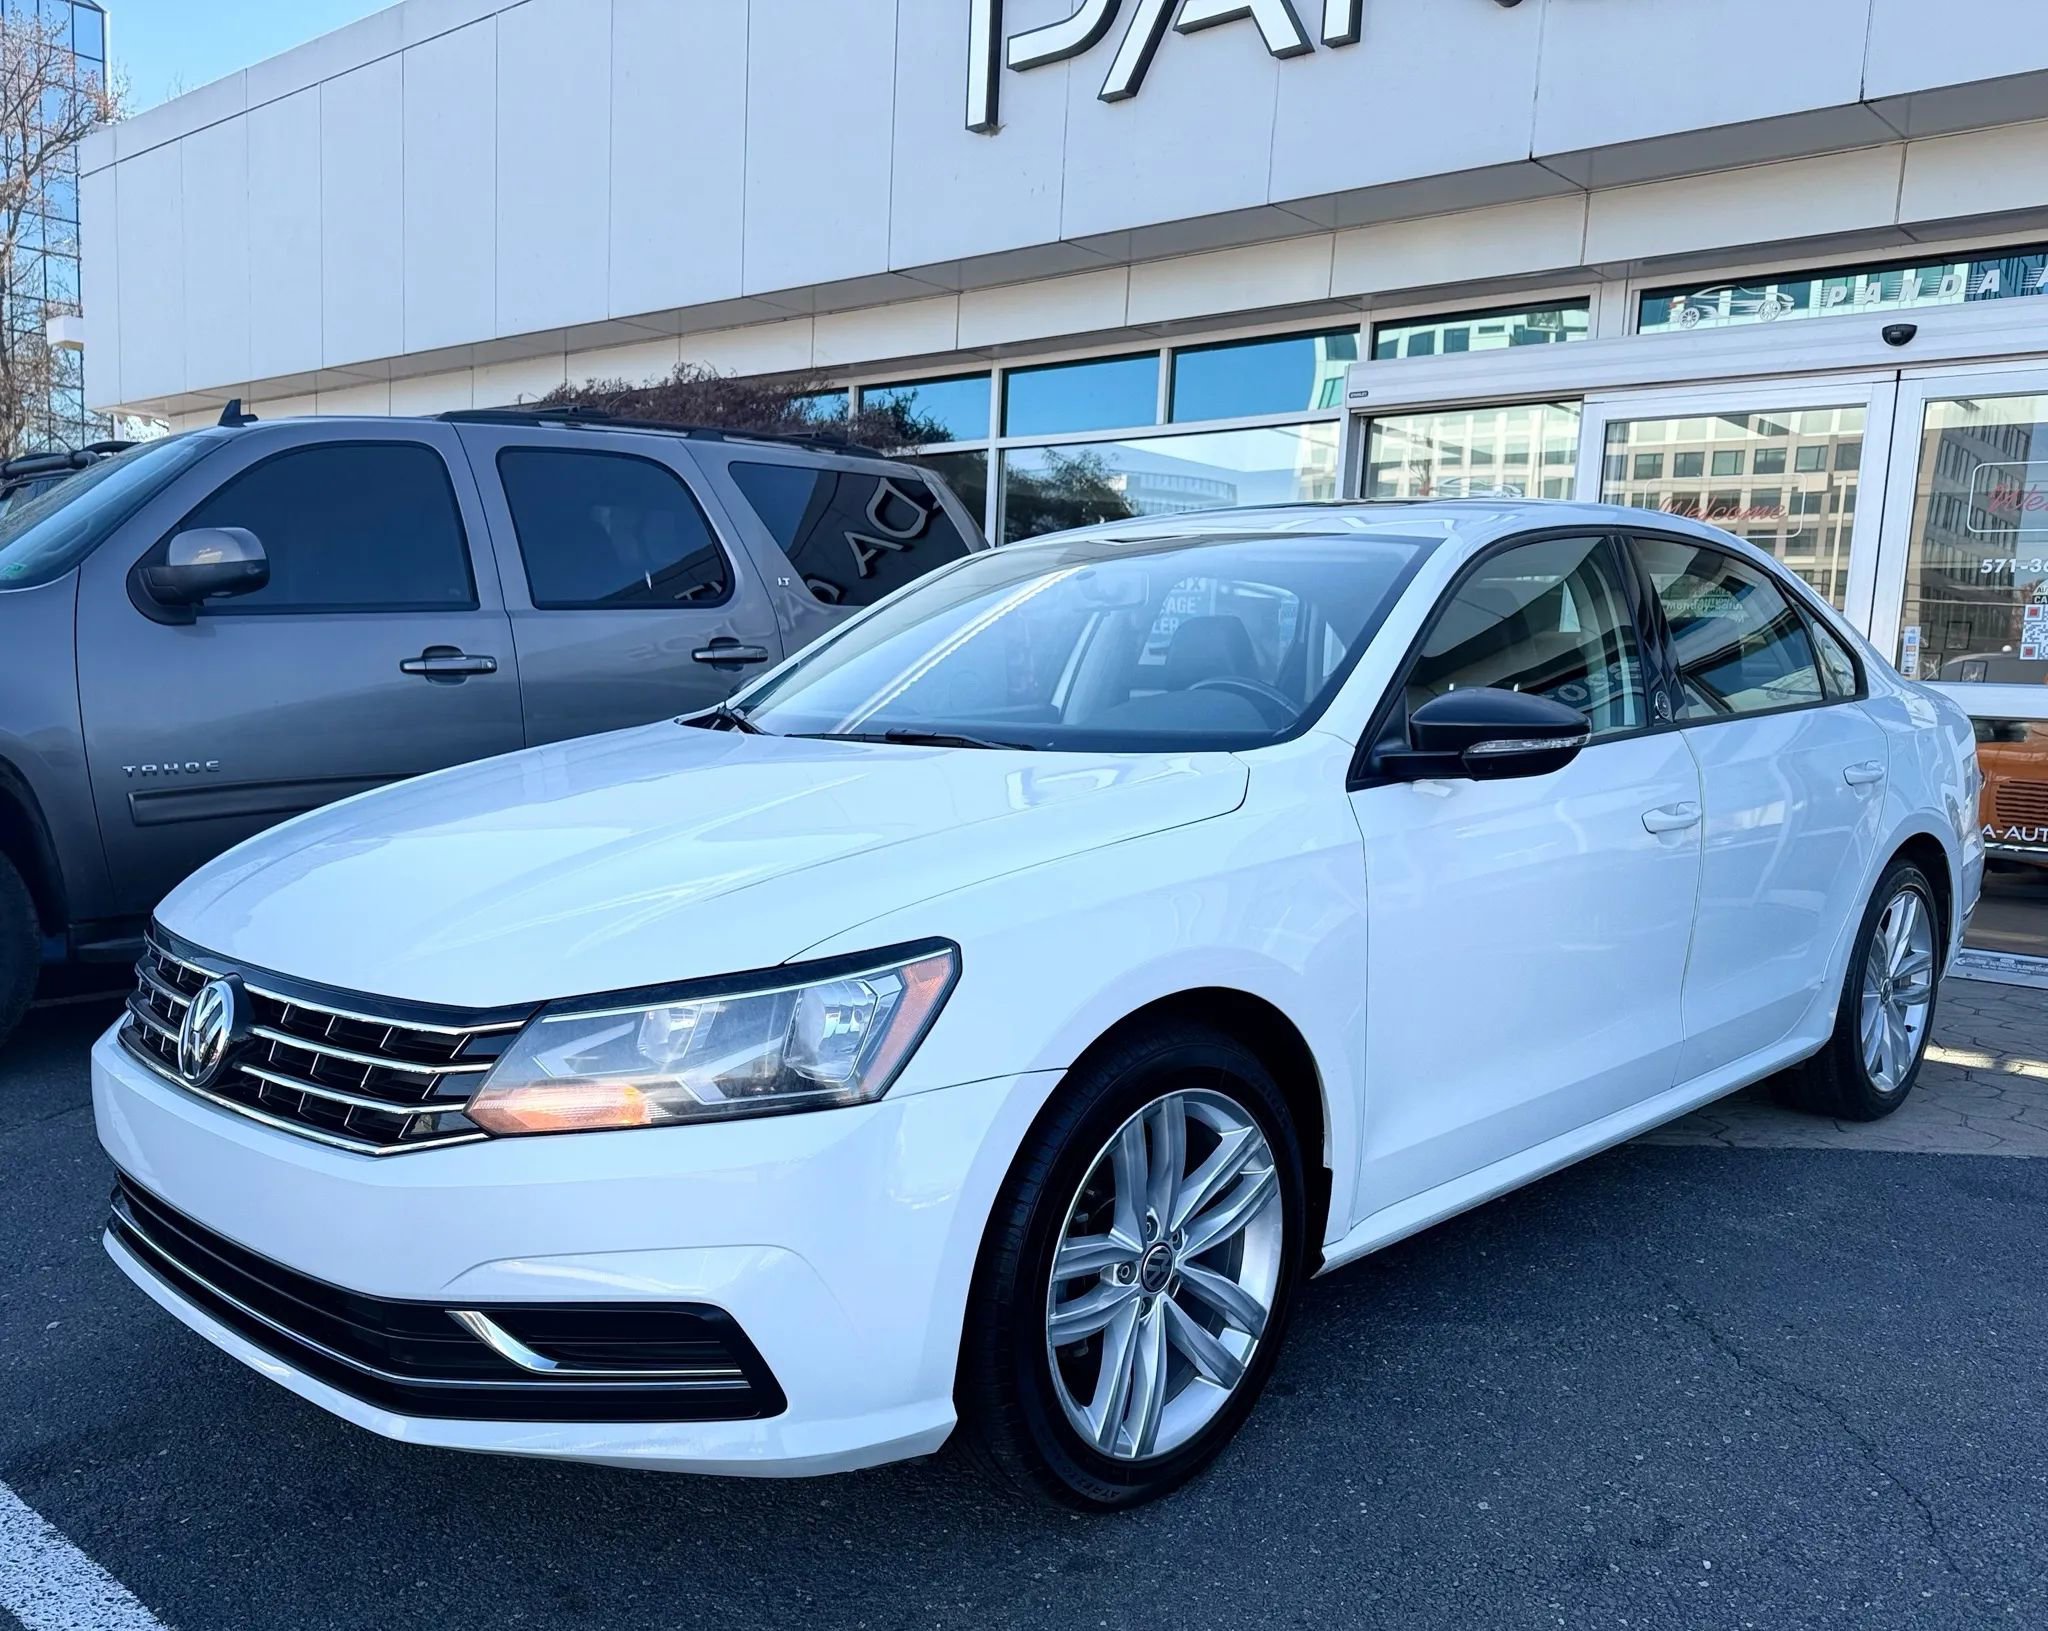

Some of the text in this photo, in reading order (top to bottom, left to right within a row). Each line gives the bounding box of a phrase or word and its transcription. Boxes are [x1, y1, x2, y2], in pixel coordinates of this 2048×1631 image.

[1826, 268, 2001, 309] PANDA
[1658, 495, 1787, 522] Welcome
[122, 760, 221, 778] TAHOE
